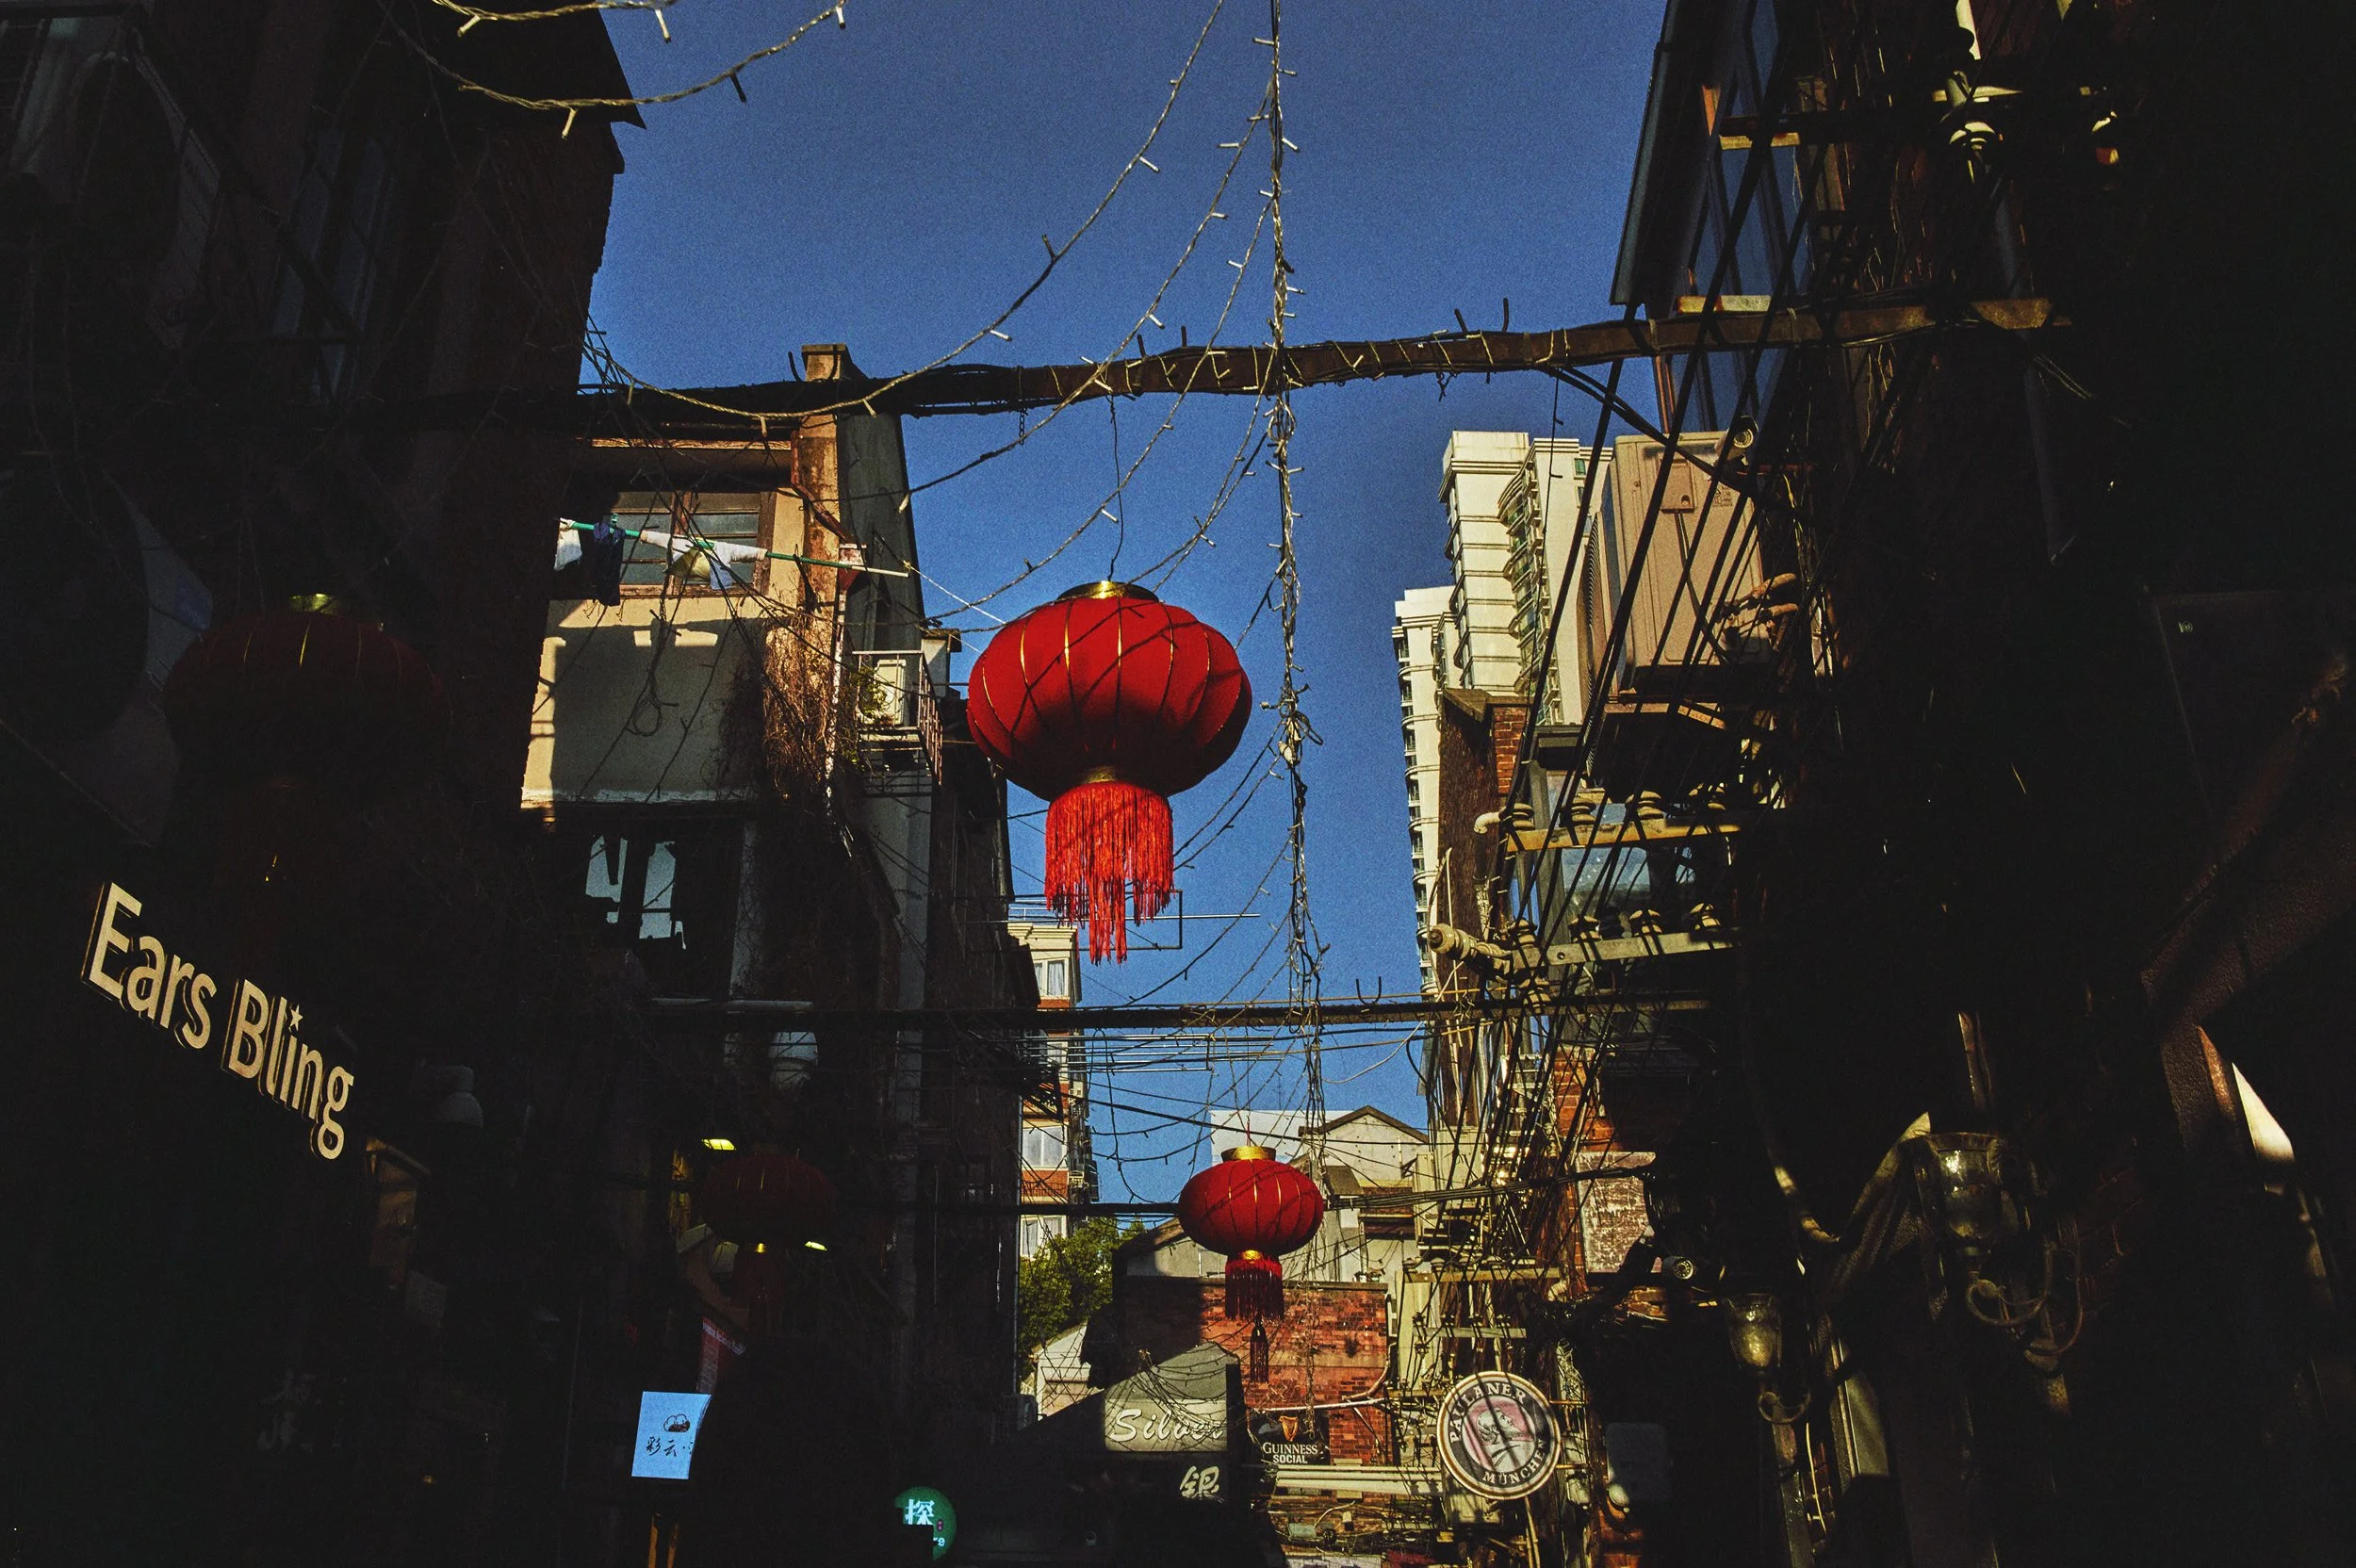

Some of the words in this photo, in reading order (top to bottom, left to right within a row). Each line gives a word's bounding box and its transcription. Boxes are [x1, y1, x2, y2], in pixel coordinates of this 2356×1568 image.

[88, 881, 218, 1050] Ears
[227, 978, 355, 1160] Bling
[1110, 1408, 1224, 1443] Silver
[1449, 1381, 1527, 1443] PAULANER
[1262, 1442, 1318, 1455] GUINNESS
[1272, 1454, 1308, 1464] SOCIAL
[1481, 1438, 1546, 1485] MÜNCHEN
